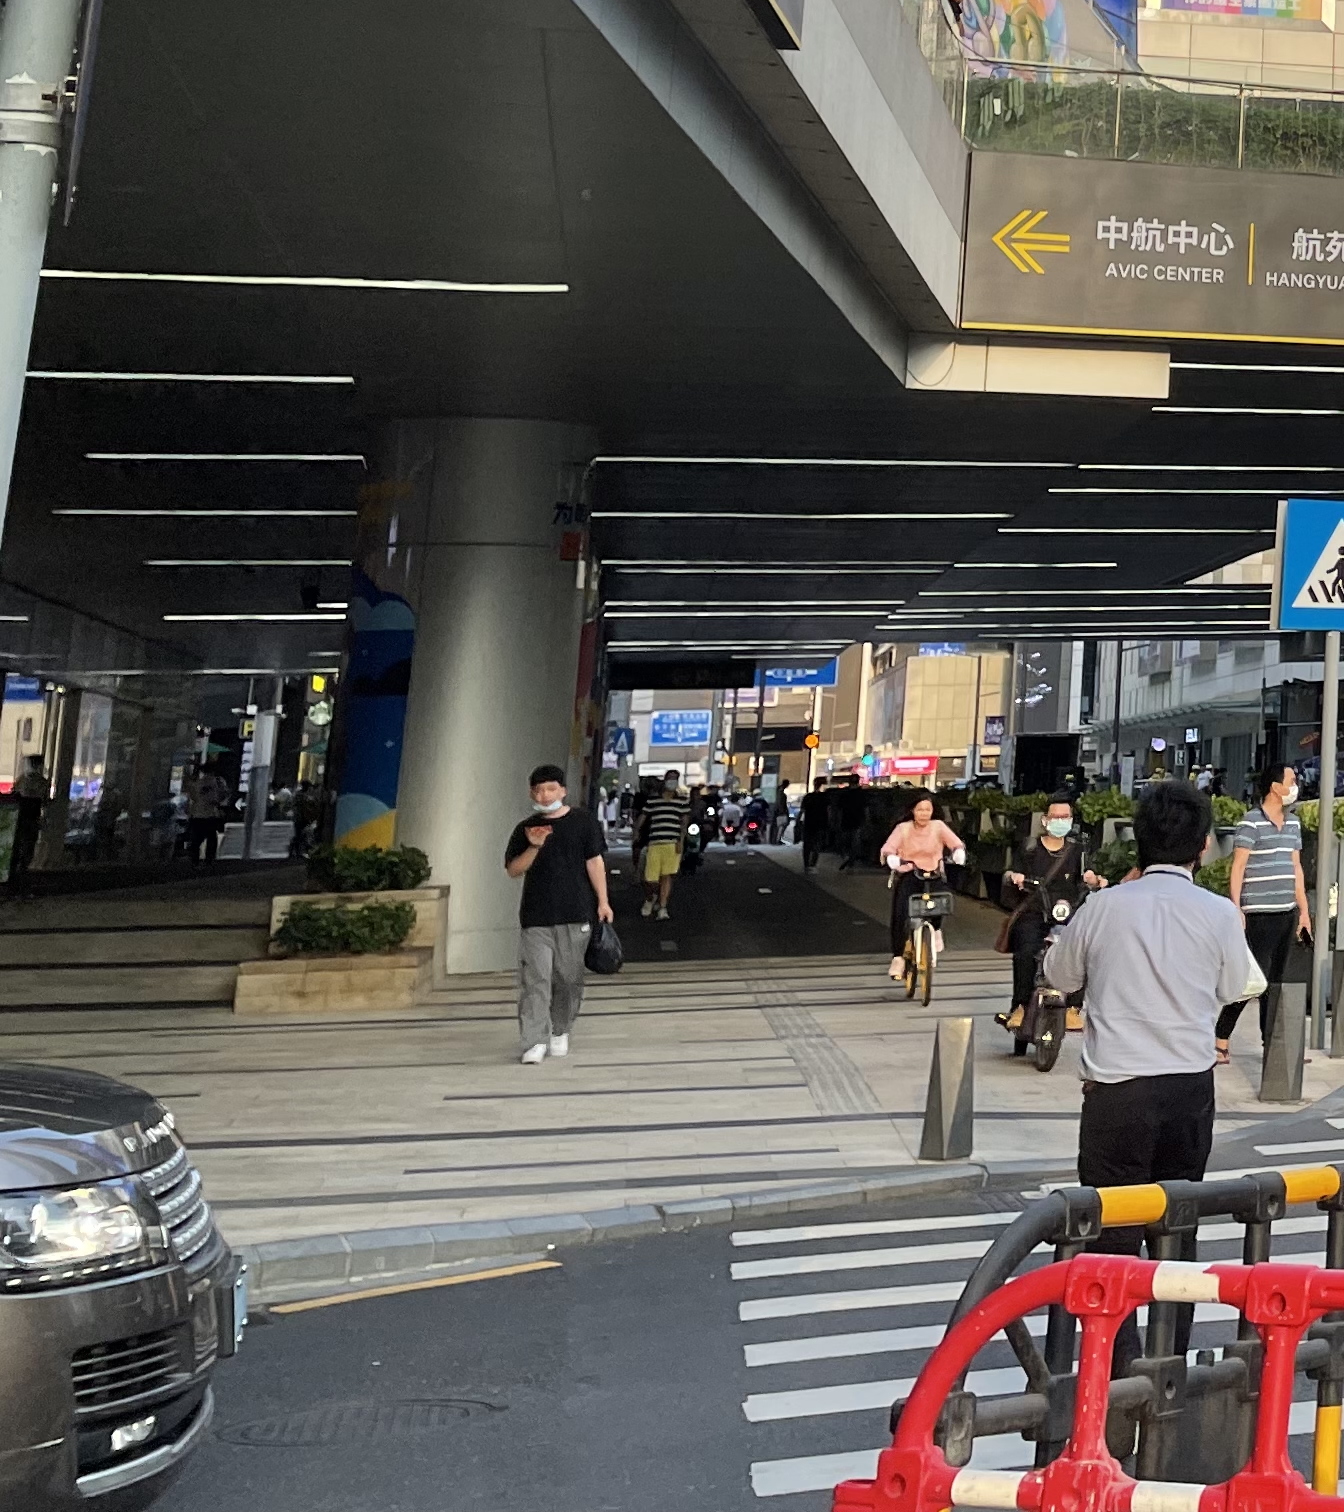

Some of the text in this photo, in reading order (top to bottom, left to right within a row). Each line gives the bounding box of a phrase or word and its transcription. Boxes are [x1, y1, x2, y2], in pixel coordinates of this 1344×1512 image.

[1096, 215, 1235, 257] 中航中心
[1105, 262, 1225, 285] AVIC CENTER
